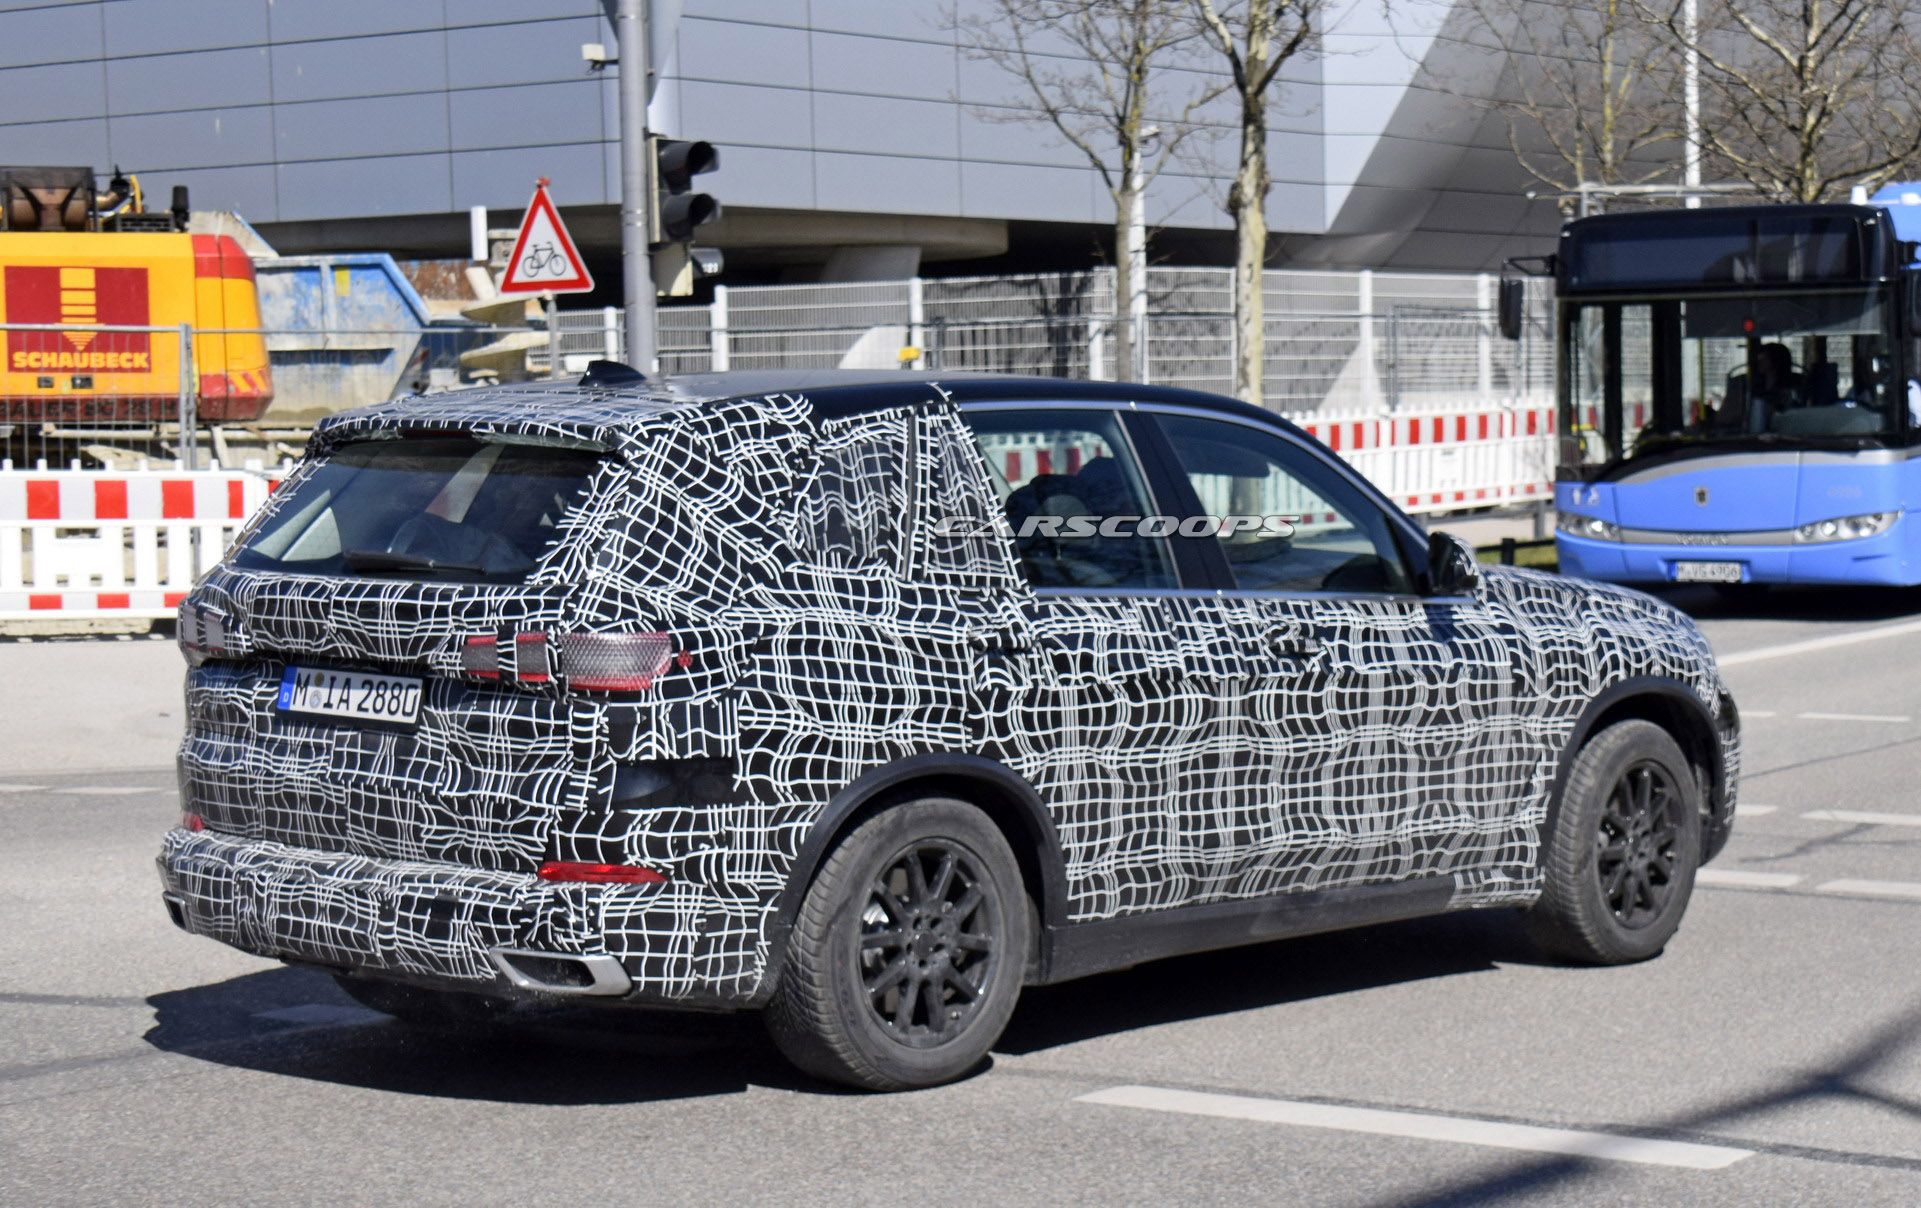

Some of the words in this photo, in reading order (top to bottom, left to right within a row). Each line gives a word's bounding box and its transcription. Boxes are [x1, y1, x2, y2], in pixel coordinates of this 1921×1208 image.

[13, 352, 149, 368] SCHAUBECK
[292, 672, 311, 707] M
[323, 675, 352, 711] IA
[357, 679, 419, 717] 2880
